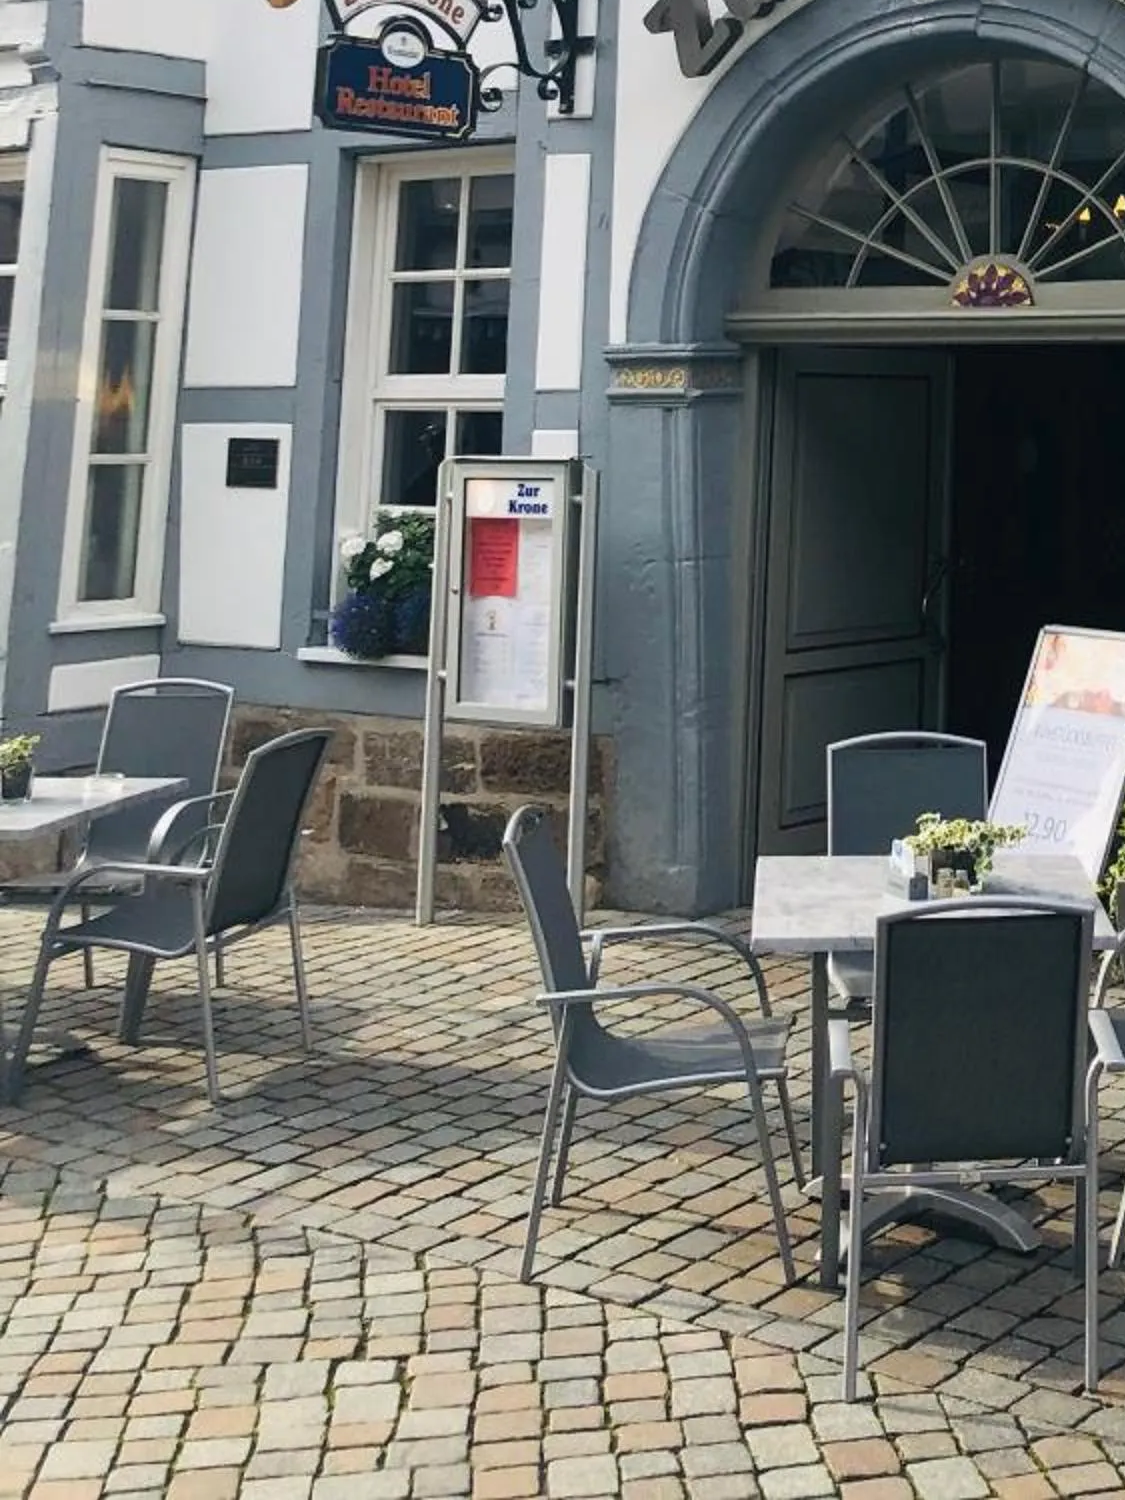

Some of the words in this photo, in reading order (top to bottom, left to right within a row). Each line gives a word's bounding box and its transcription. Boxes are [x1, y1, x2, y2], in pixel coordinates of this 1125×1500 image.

[367, 66, 431, 100] Hotel
[335, 86, 460, 128] Restaurant
[517, 483, 540, 498] Zur
[508, 499, 549, 515] Krone
